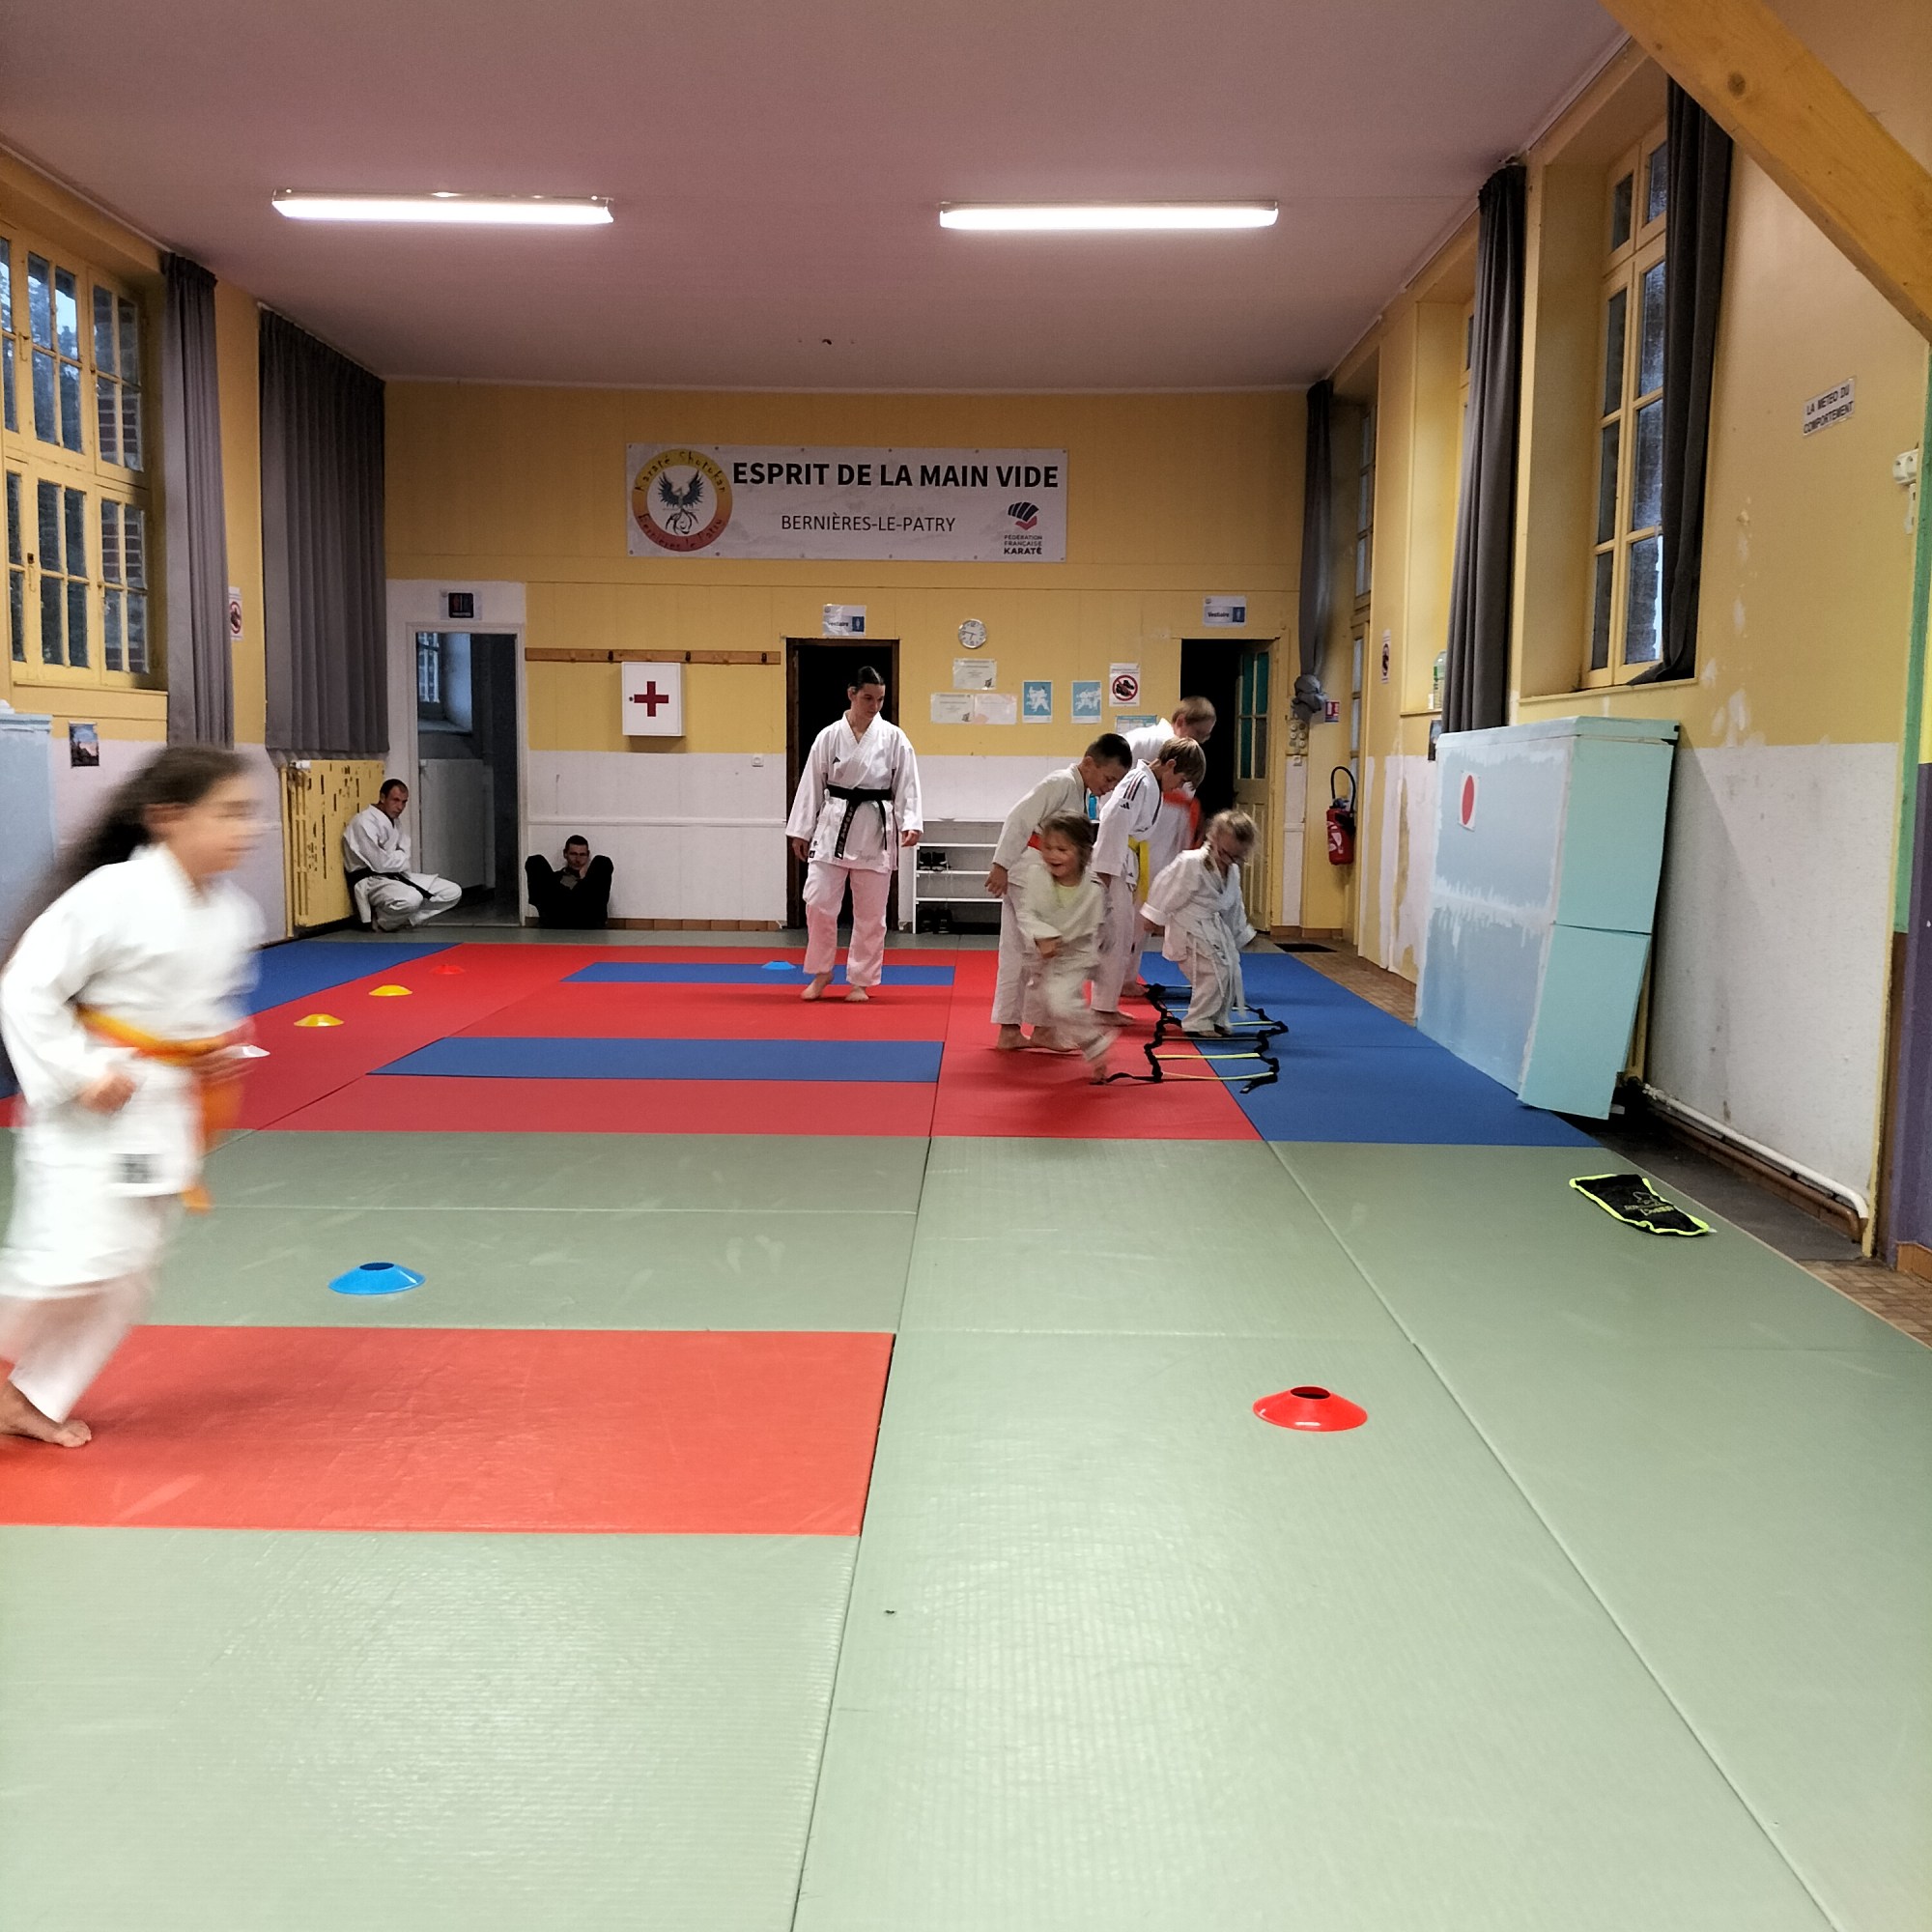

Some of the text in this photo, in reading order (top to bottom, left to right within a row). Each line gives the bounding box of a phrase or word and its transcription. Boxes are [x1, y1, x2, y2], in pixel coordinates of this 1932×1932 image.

[1806, 403, 1815, 415] LA
[1840, 384, 1850, 398] DU
[733, 463, 1058, 488] ESPRIT DE LA MAIN VIDE
[781, 512, 955, 532] BERNIÈRES-LE-PATRY
